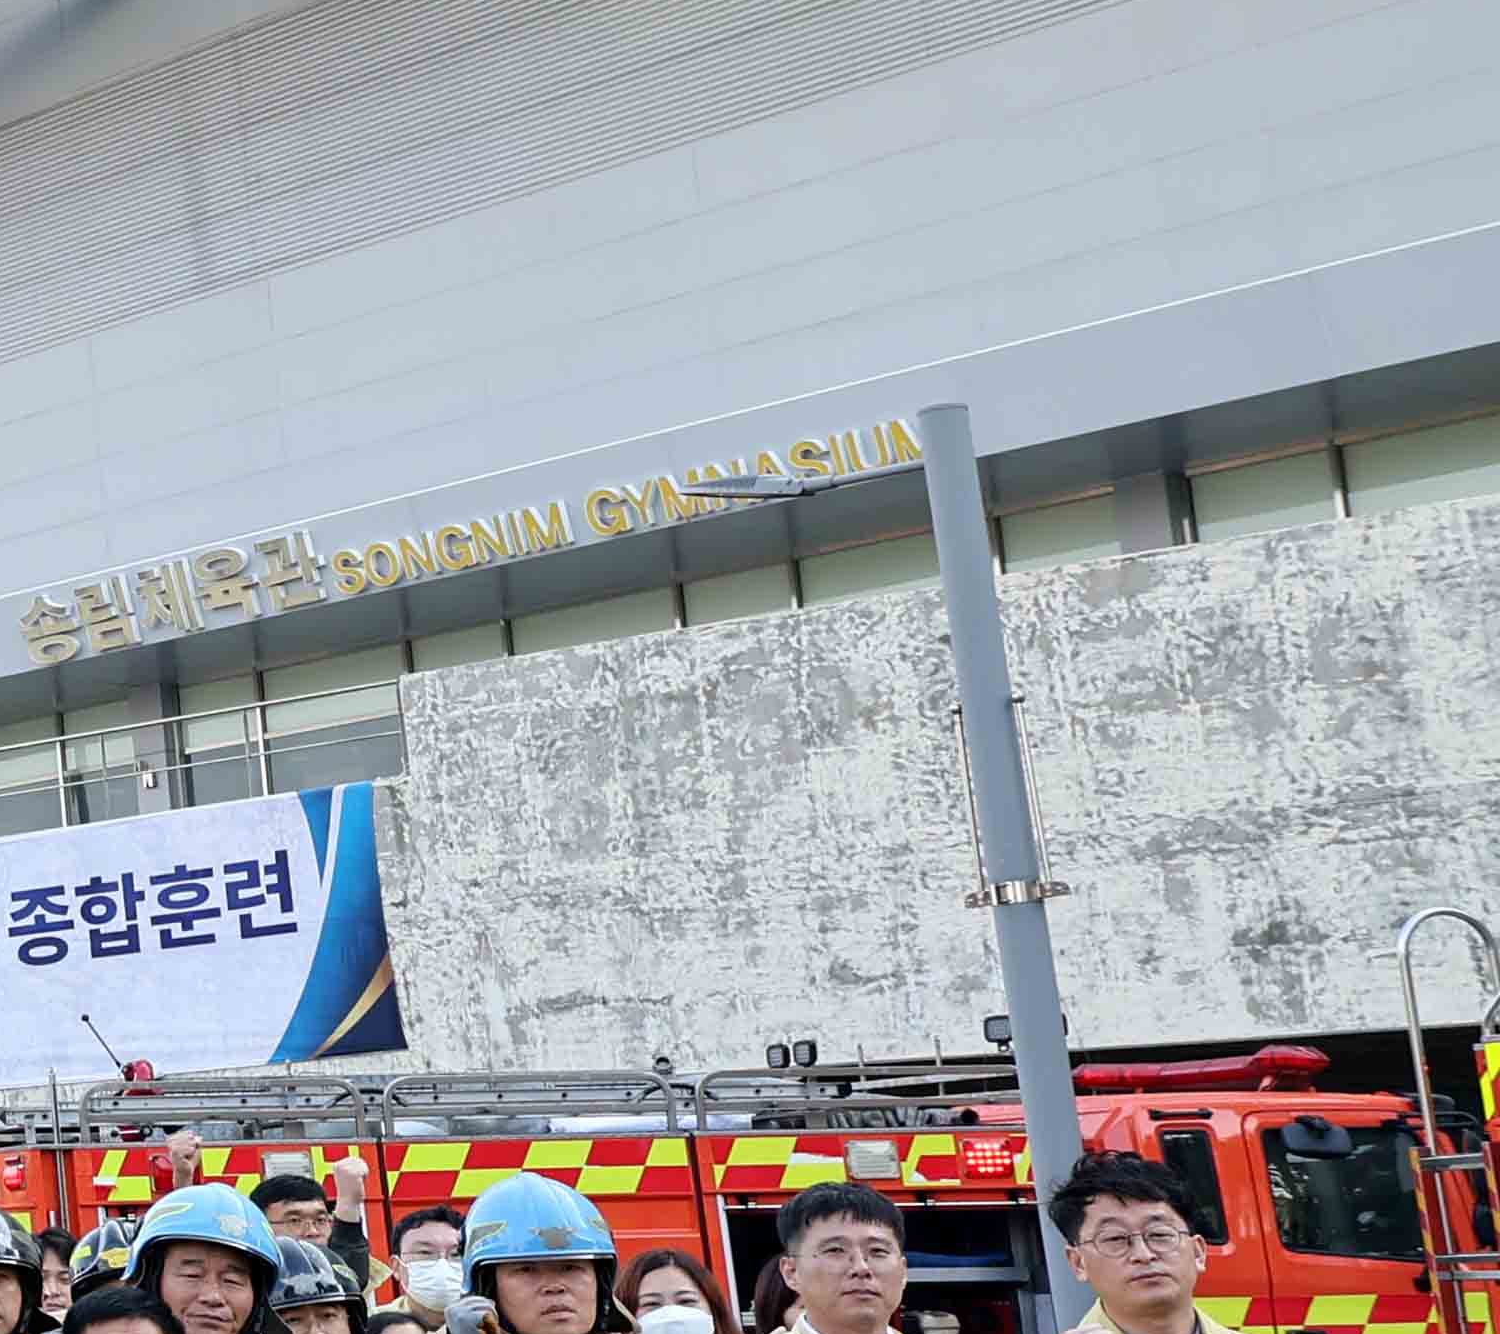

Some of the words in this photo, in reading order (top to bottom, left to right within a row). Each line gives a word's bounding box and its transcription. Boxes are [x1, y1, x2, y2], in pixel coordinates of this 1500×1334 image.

[19, 528, 325, 665] 송림체육관
[333, 499, 574, 596] SONGNIM
[7, 849, 300, 968] 종합훈련
